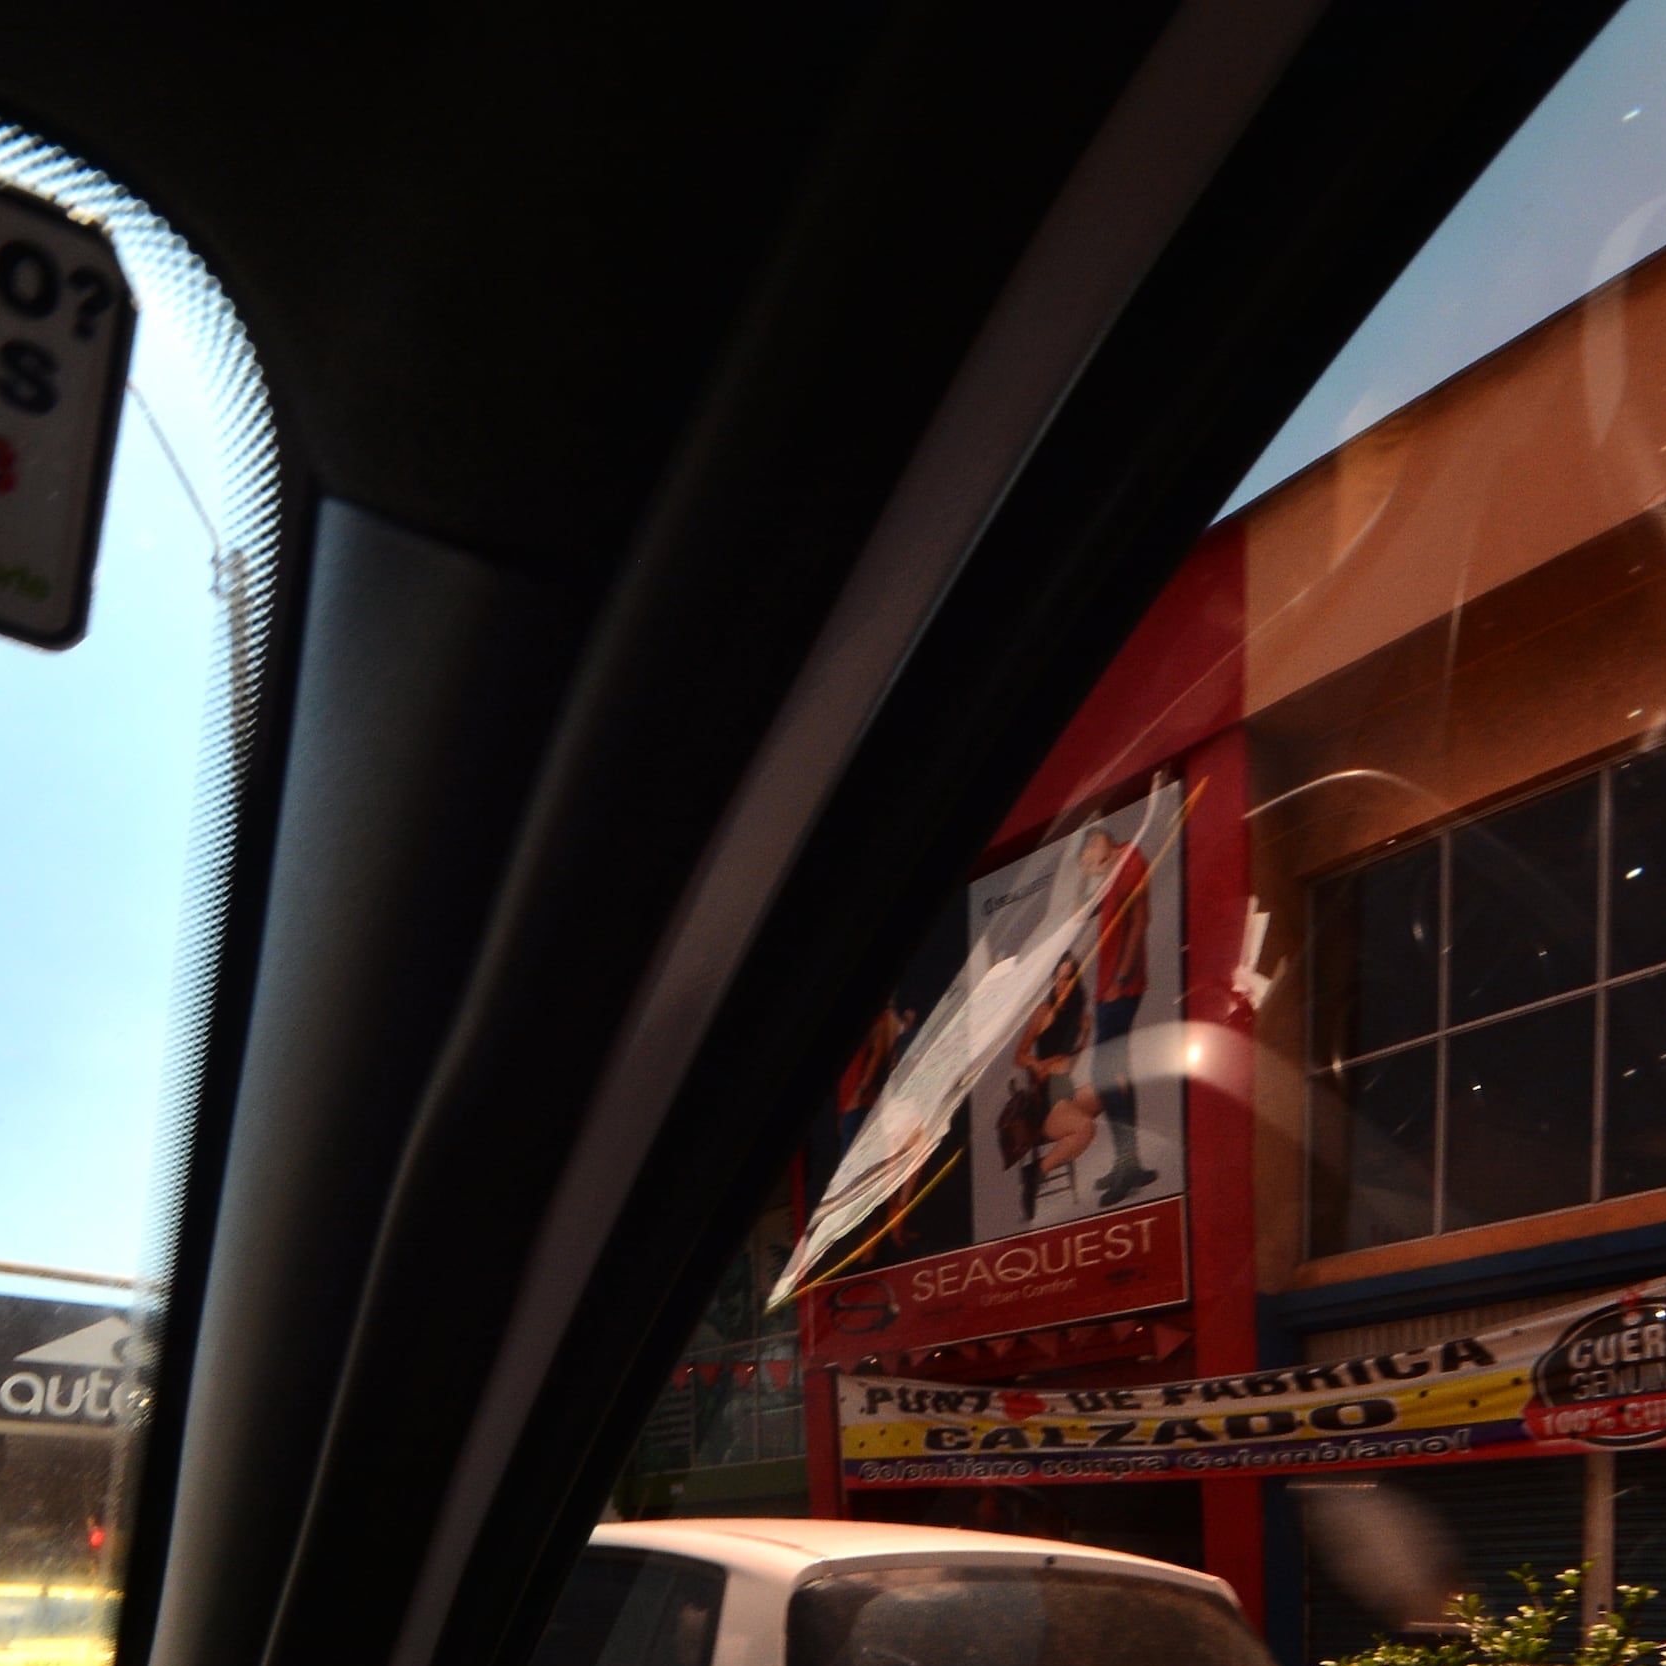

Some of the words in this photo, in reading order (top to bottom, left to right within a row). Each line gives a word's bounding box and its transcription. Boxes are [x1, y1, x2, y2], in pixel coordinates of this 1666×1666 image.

[910, 1216, 1159, 1303] SEAQUEST
[1021, 1276, 1078, 1301] Comfort
[923, 1397, 1399, 1452] CALZADO
[1542, 1405, 1617, 1436] 100%
[858, 1456, 1033, 1482] Colombiano
[1039, 1452, 1171, 1479] compra
